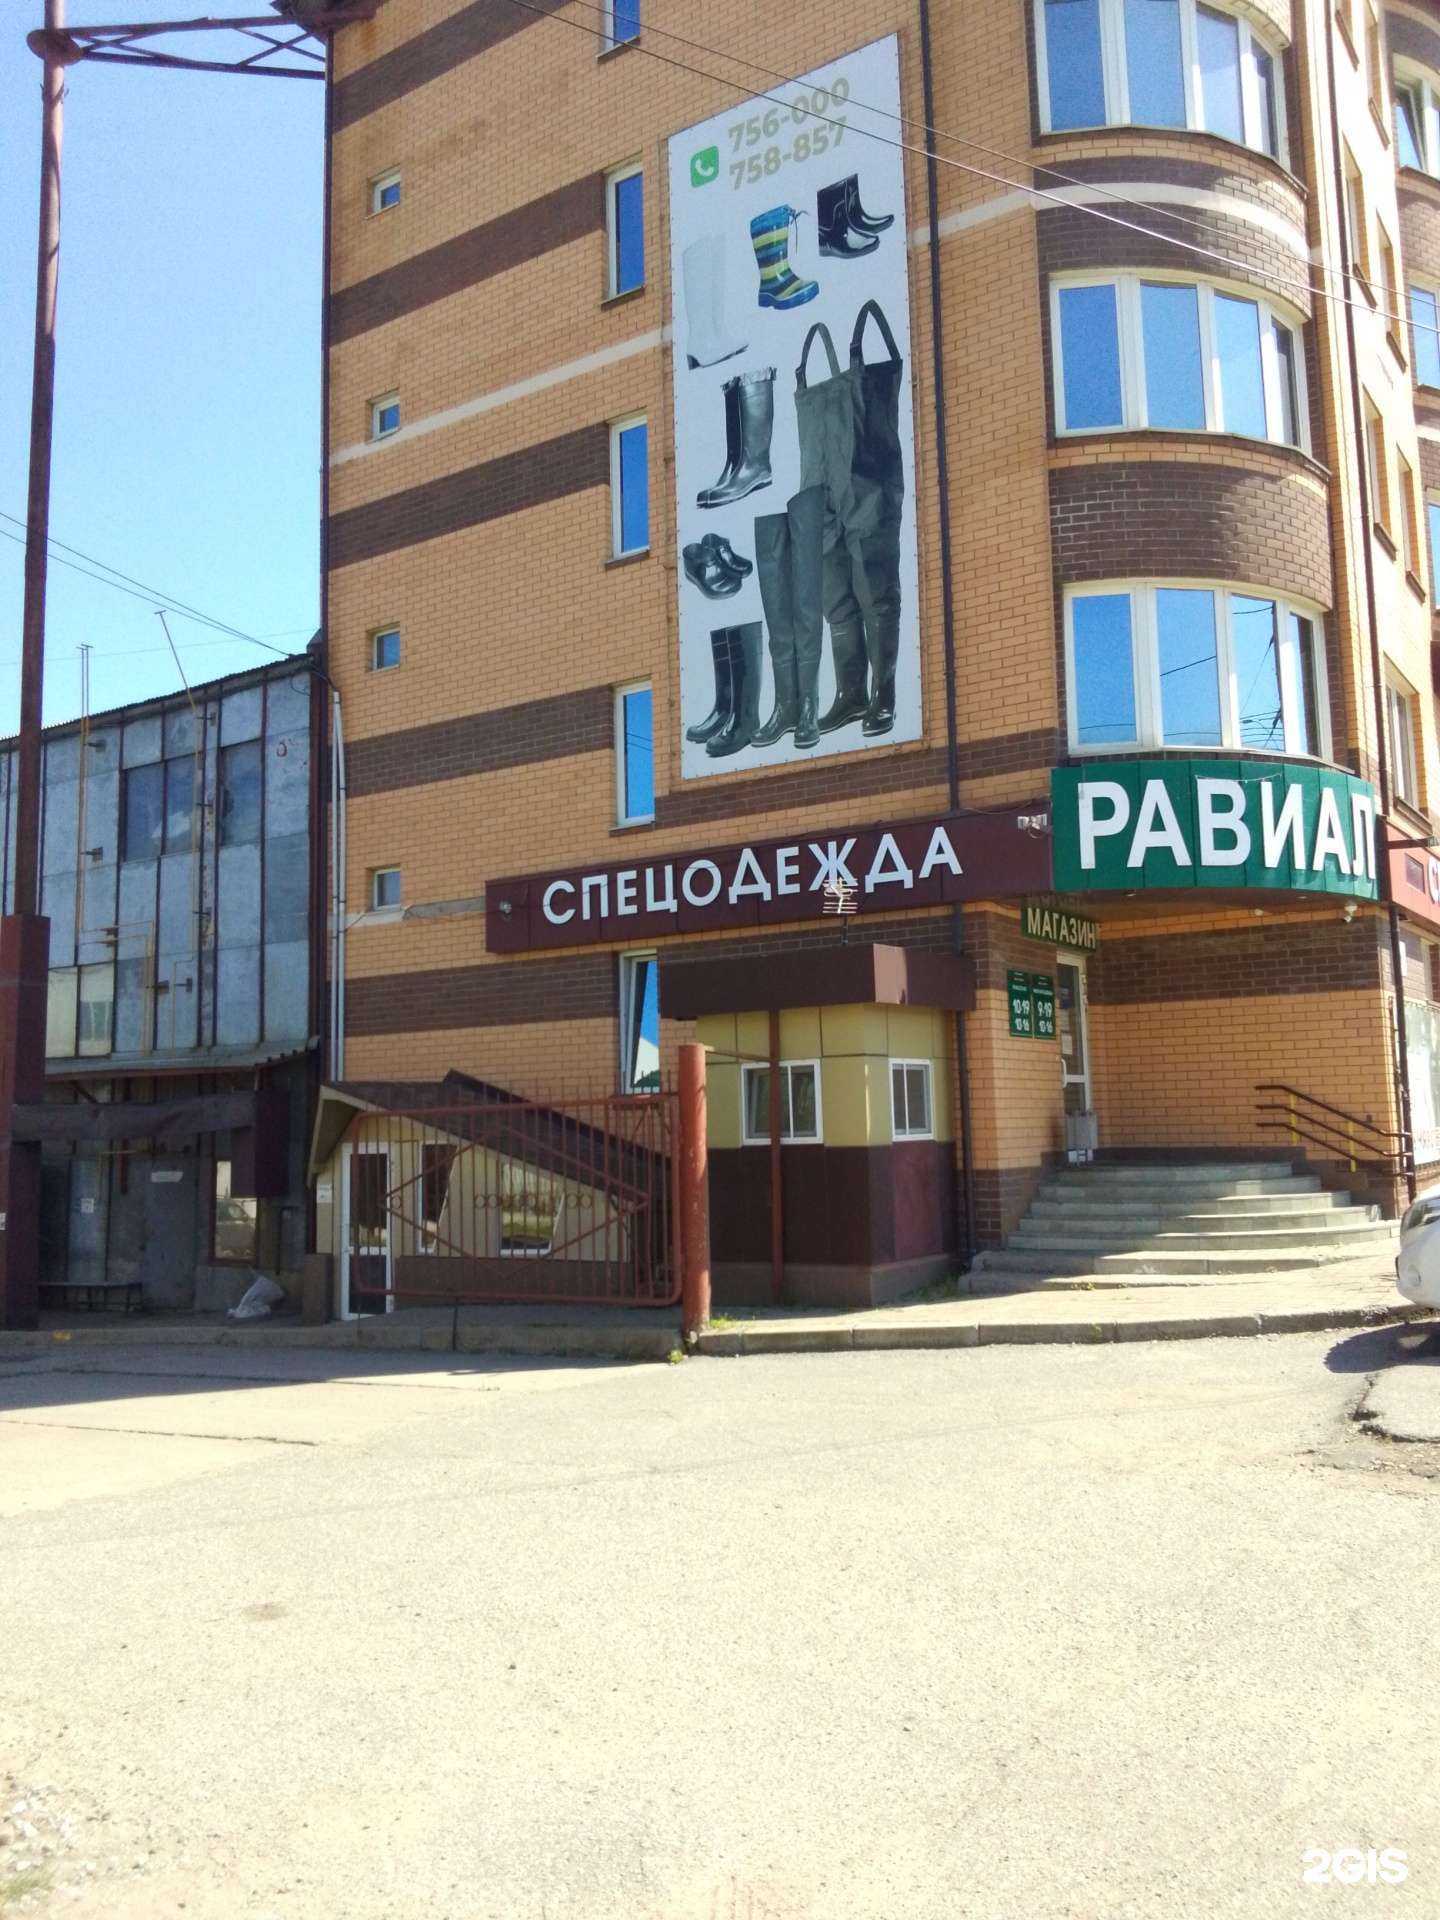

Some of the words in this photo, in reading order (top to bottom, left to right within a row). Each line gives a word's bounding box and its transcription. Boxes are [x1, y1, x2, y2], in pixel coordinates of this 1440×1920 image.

[728, 78, 849, 154] 756-000
[729, 115, 847, 191] 758-857
[1078, 778, 1376, 880] РАВИАЛ
[542, 826, 963, 925] СПЕЦОДЕЖДА
[1027, 907, 1097, 949] МАГАЗИН
